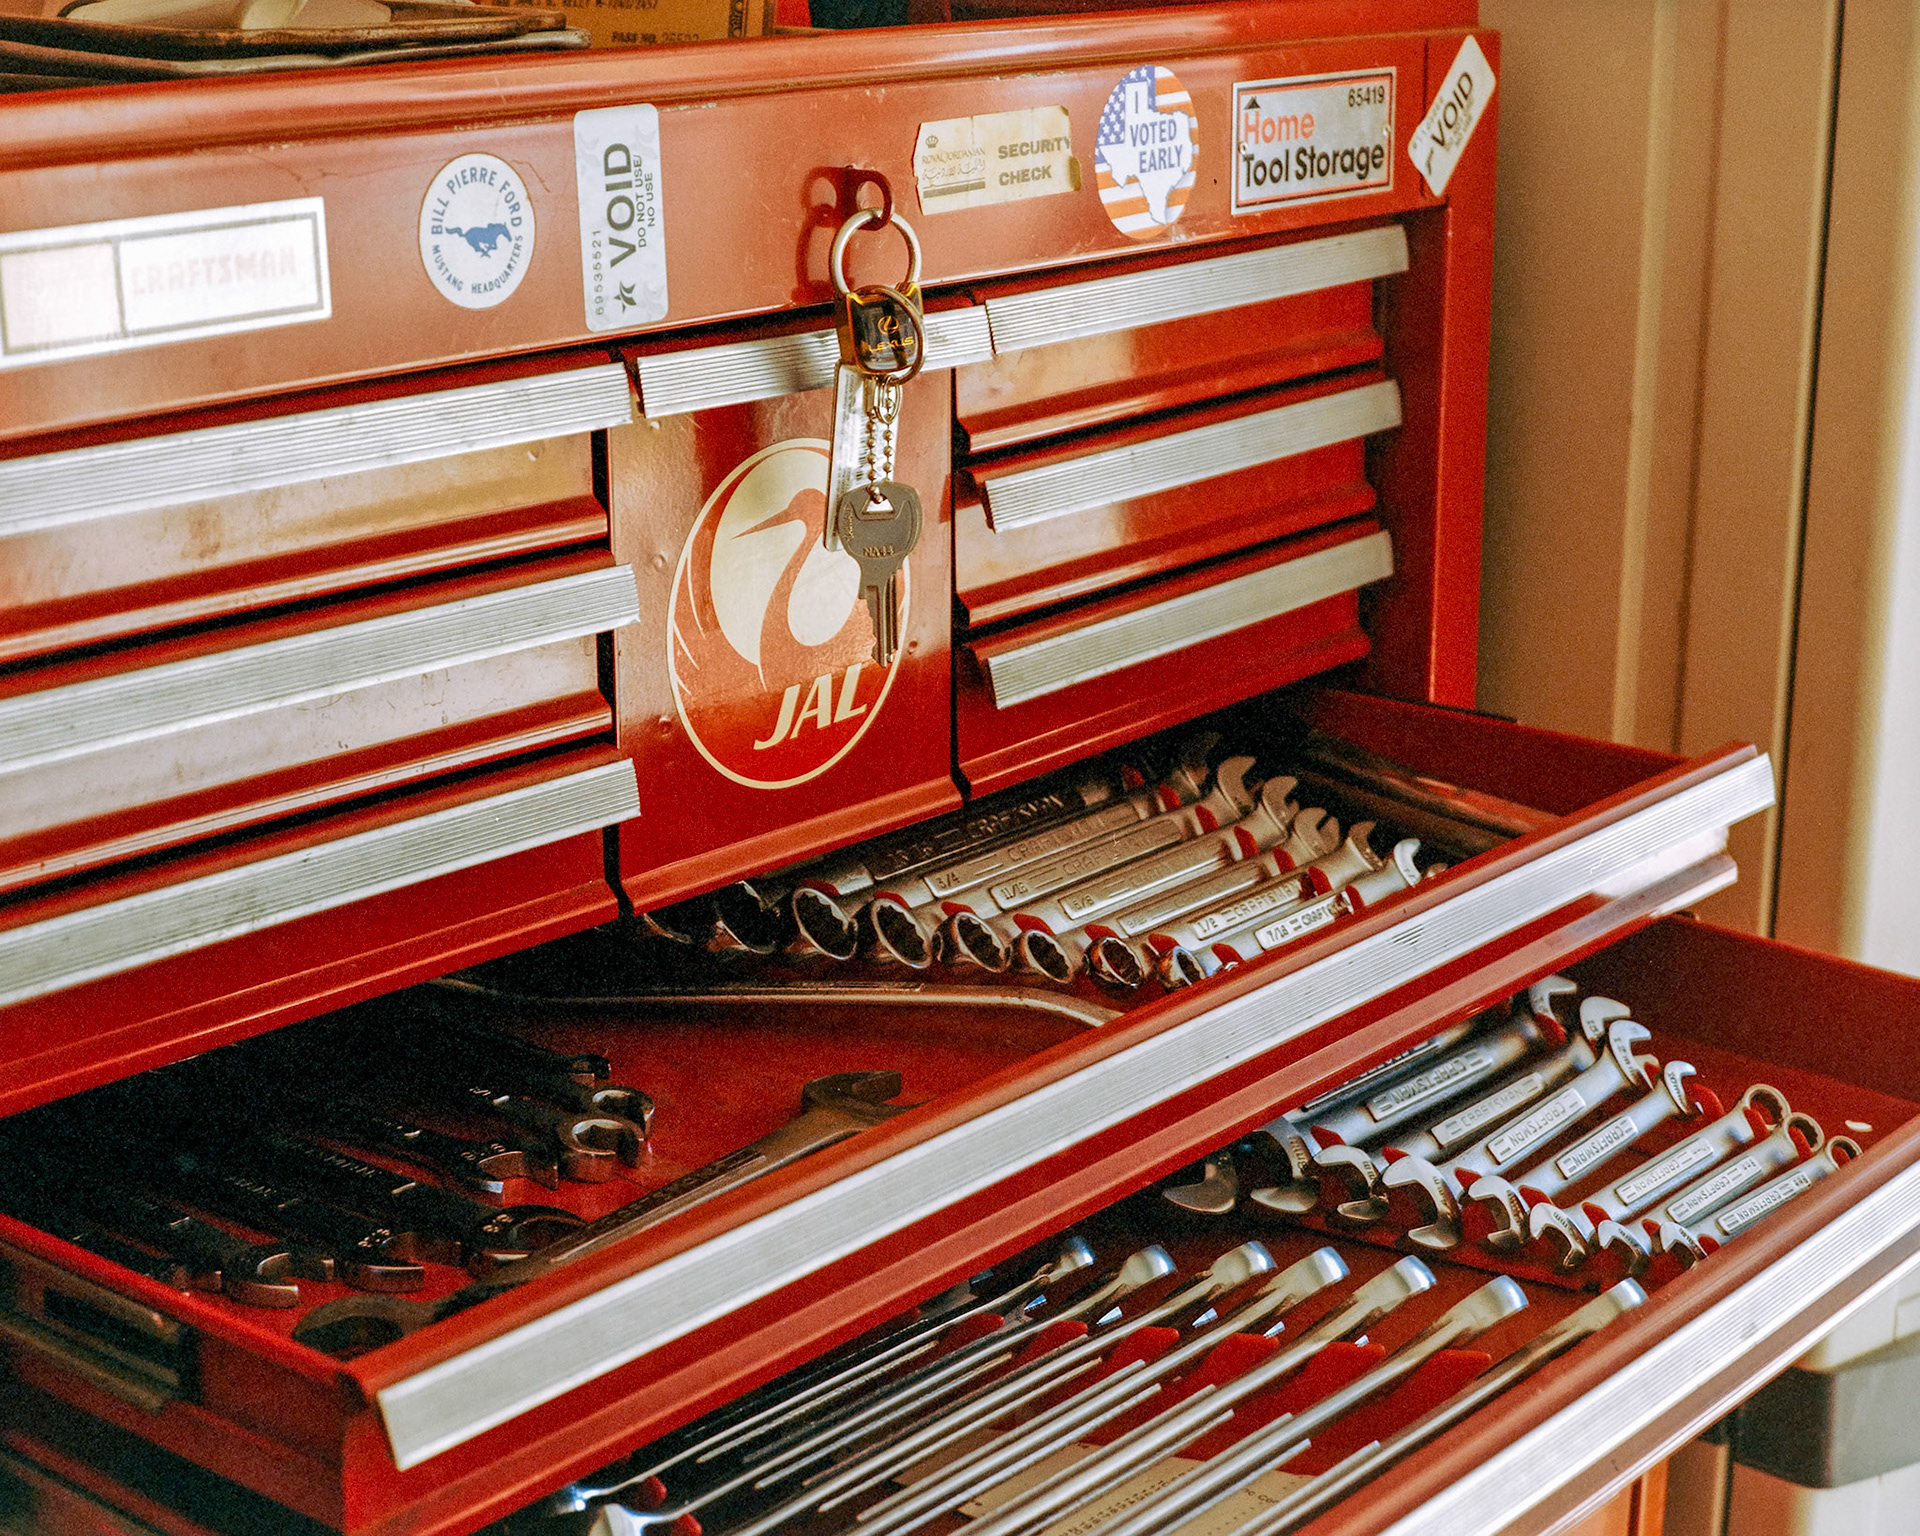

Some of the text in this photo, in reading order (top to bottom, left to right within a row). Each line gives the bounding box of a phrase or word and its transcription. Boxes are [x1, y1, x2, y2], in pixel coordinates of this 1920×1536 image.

[1134, 90, 1140, 115] I
[1348, 85, 1386, 108] 65419
[1430, 71, 1474, 147] VOID
[998, 135, 1071, 160] SECURITY
[1130, 118, 1178, 147] VOTED
[1243, 111, 1315, 145] Home
[999, 165, 1052, 187] CHECK
[1139, 144, 1183, 174] EARLY
[1243, 143, 1385, 188] Tool Storage
[431, 167, 522, 235] BILL PIERRE FORD
[603, 142, 637, 269] VOID
[633, 154, 648, 248] DO NOT USE/
[644, 172, 655, 227] NO USE
[131, 246, 298, 296] CRAFTSMAN
[432, 235, 524, 294] MUSTANG HEADQUARTERS
[868, 335, 914, 354] LEXUS
[753, 662, 868, 750] JAL
[937, 871, 962, 891] 3/4
[1000, 880, 1029, 901] 11/16
[1196, 916, 1219, 934] 1/2
[1234, 879, 1303, 918] CRAFTSMAN
[1265, 924, 1289, 943] 7/16
[1389, 1057, 1467, 1105] CRAFTSMAN
[1508, 1102, 1567, 1147] CRAFTSMAN
[1571, 1125, 1626, 1168] CRAFTSMAN
[1632, 1155, 1682, 1196] CRAFTSMAN
[1683, 1174, 1733, 1213] CRAFTSMAN
[1735, 1188, 1781, 1224] CRAFTSMAN
